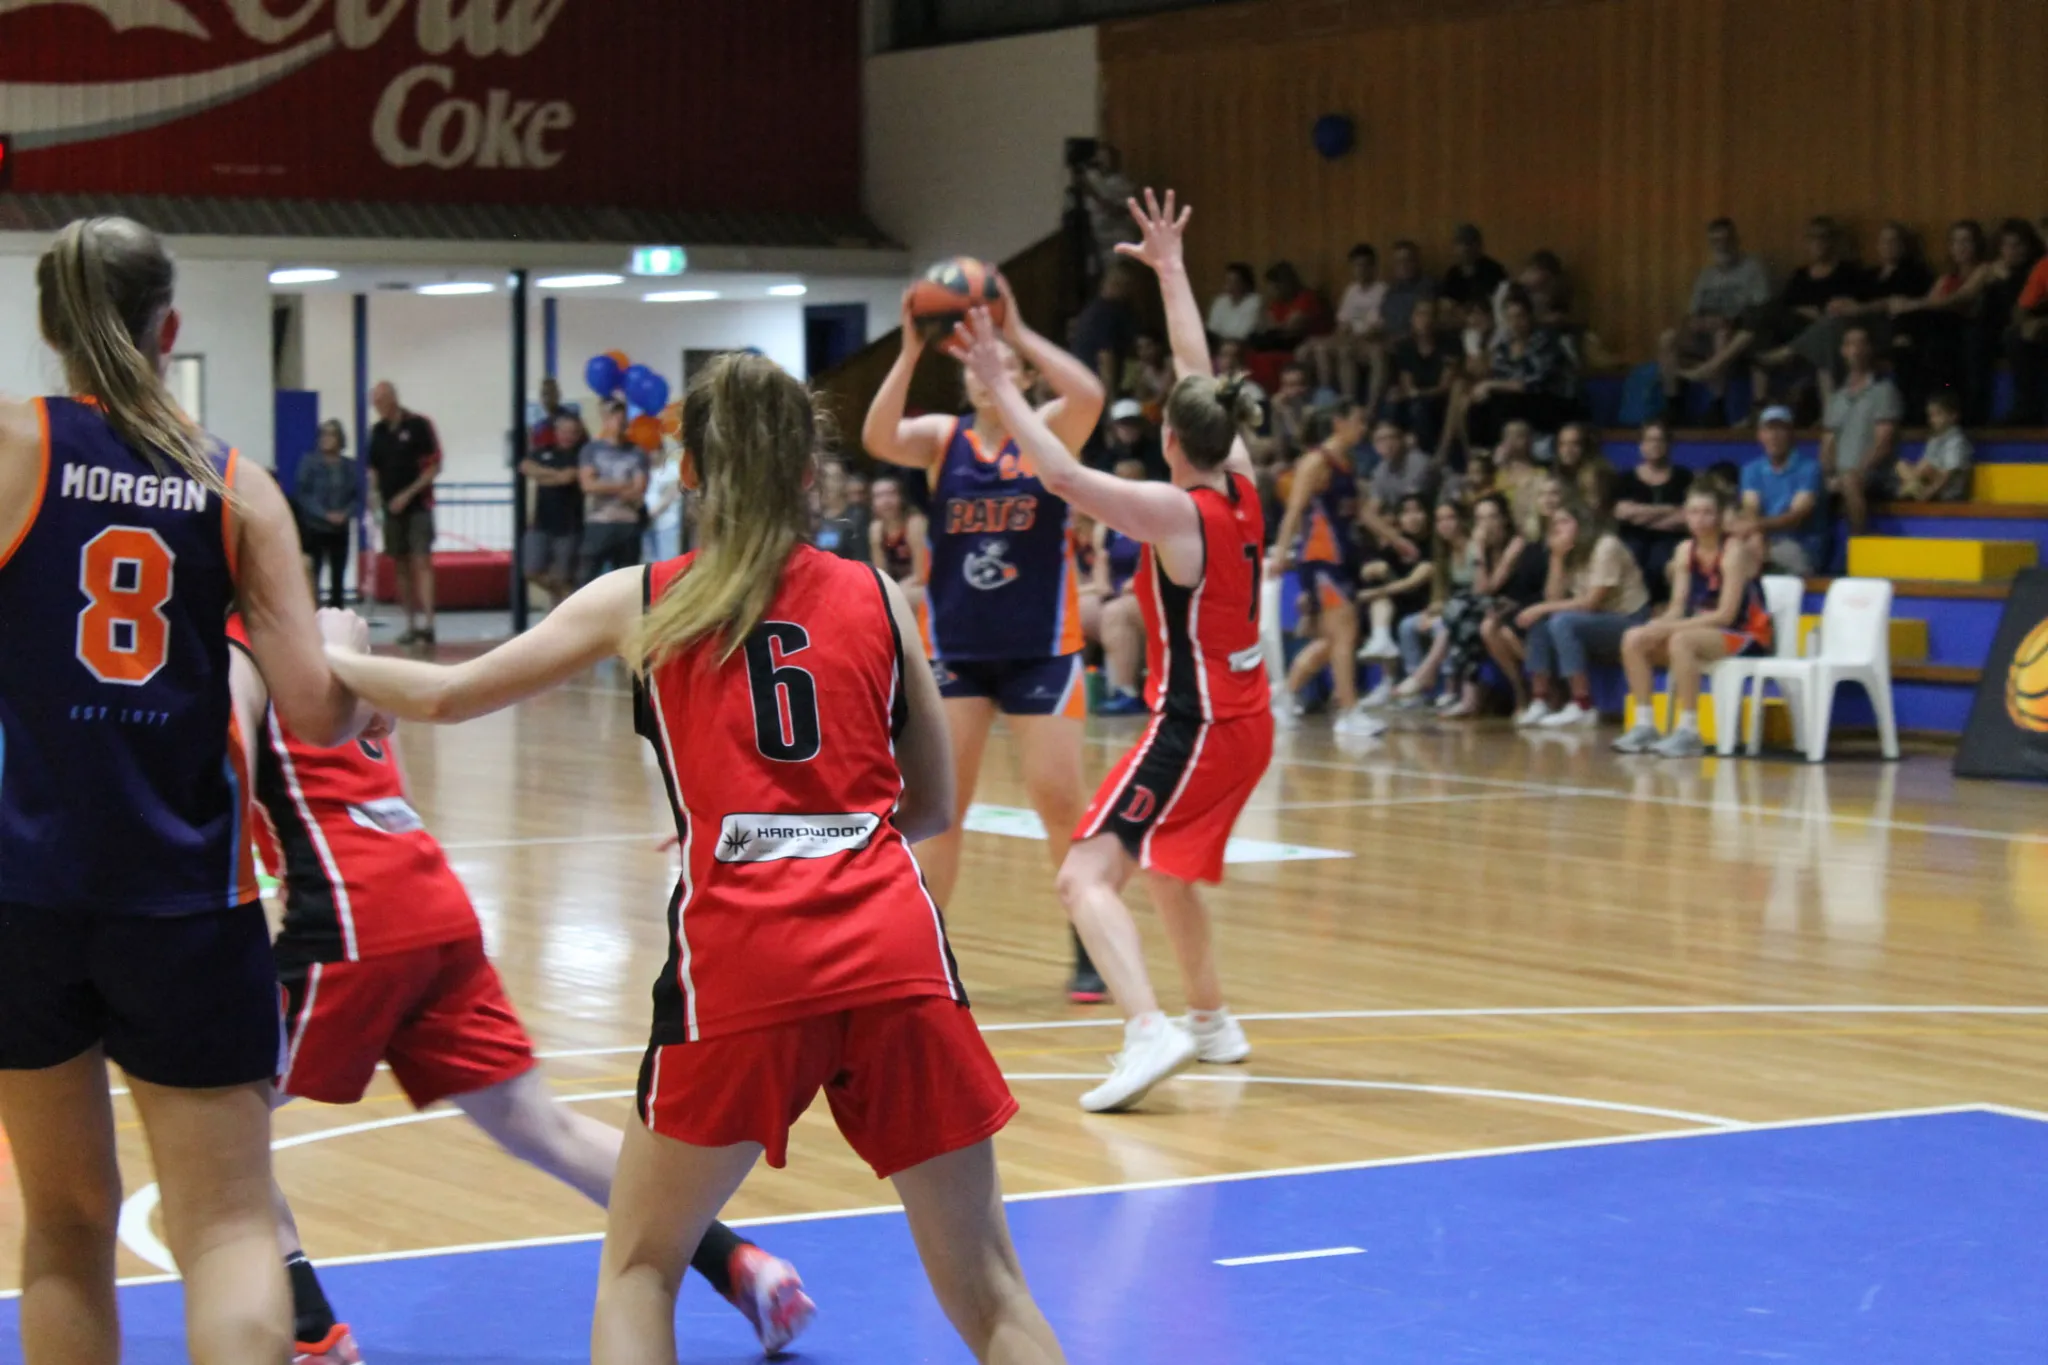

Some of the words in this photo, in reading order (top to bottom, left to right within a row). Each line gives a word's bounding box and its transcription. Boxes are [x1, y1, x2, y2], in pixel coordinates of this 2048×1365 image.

[372, 63, 575, 169] Coke
[61, 463, 208, 511] MORGAN
[76, 525, 176, 686] 8
[744, 620, 821, 763] 6
[1118, 784, 1156, 822] D
